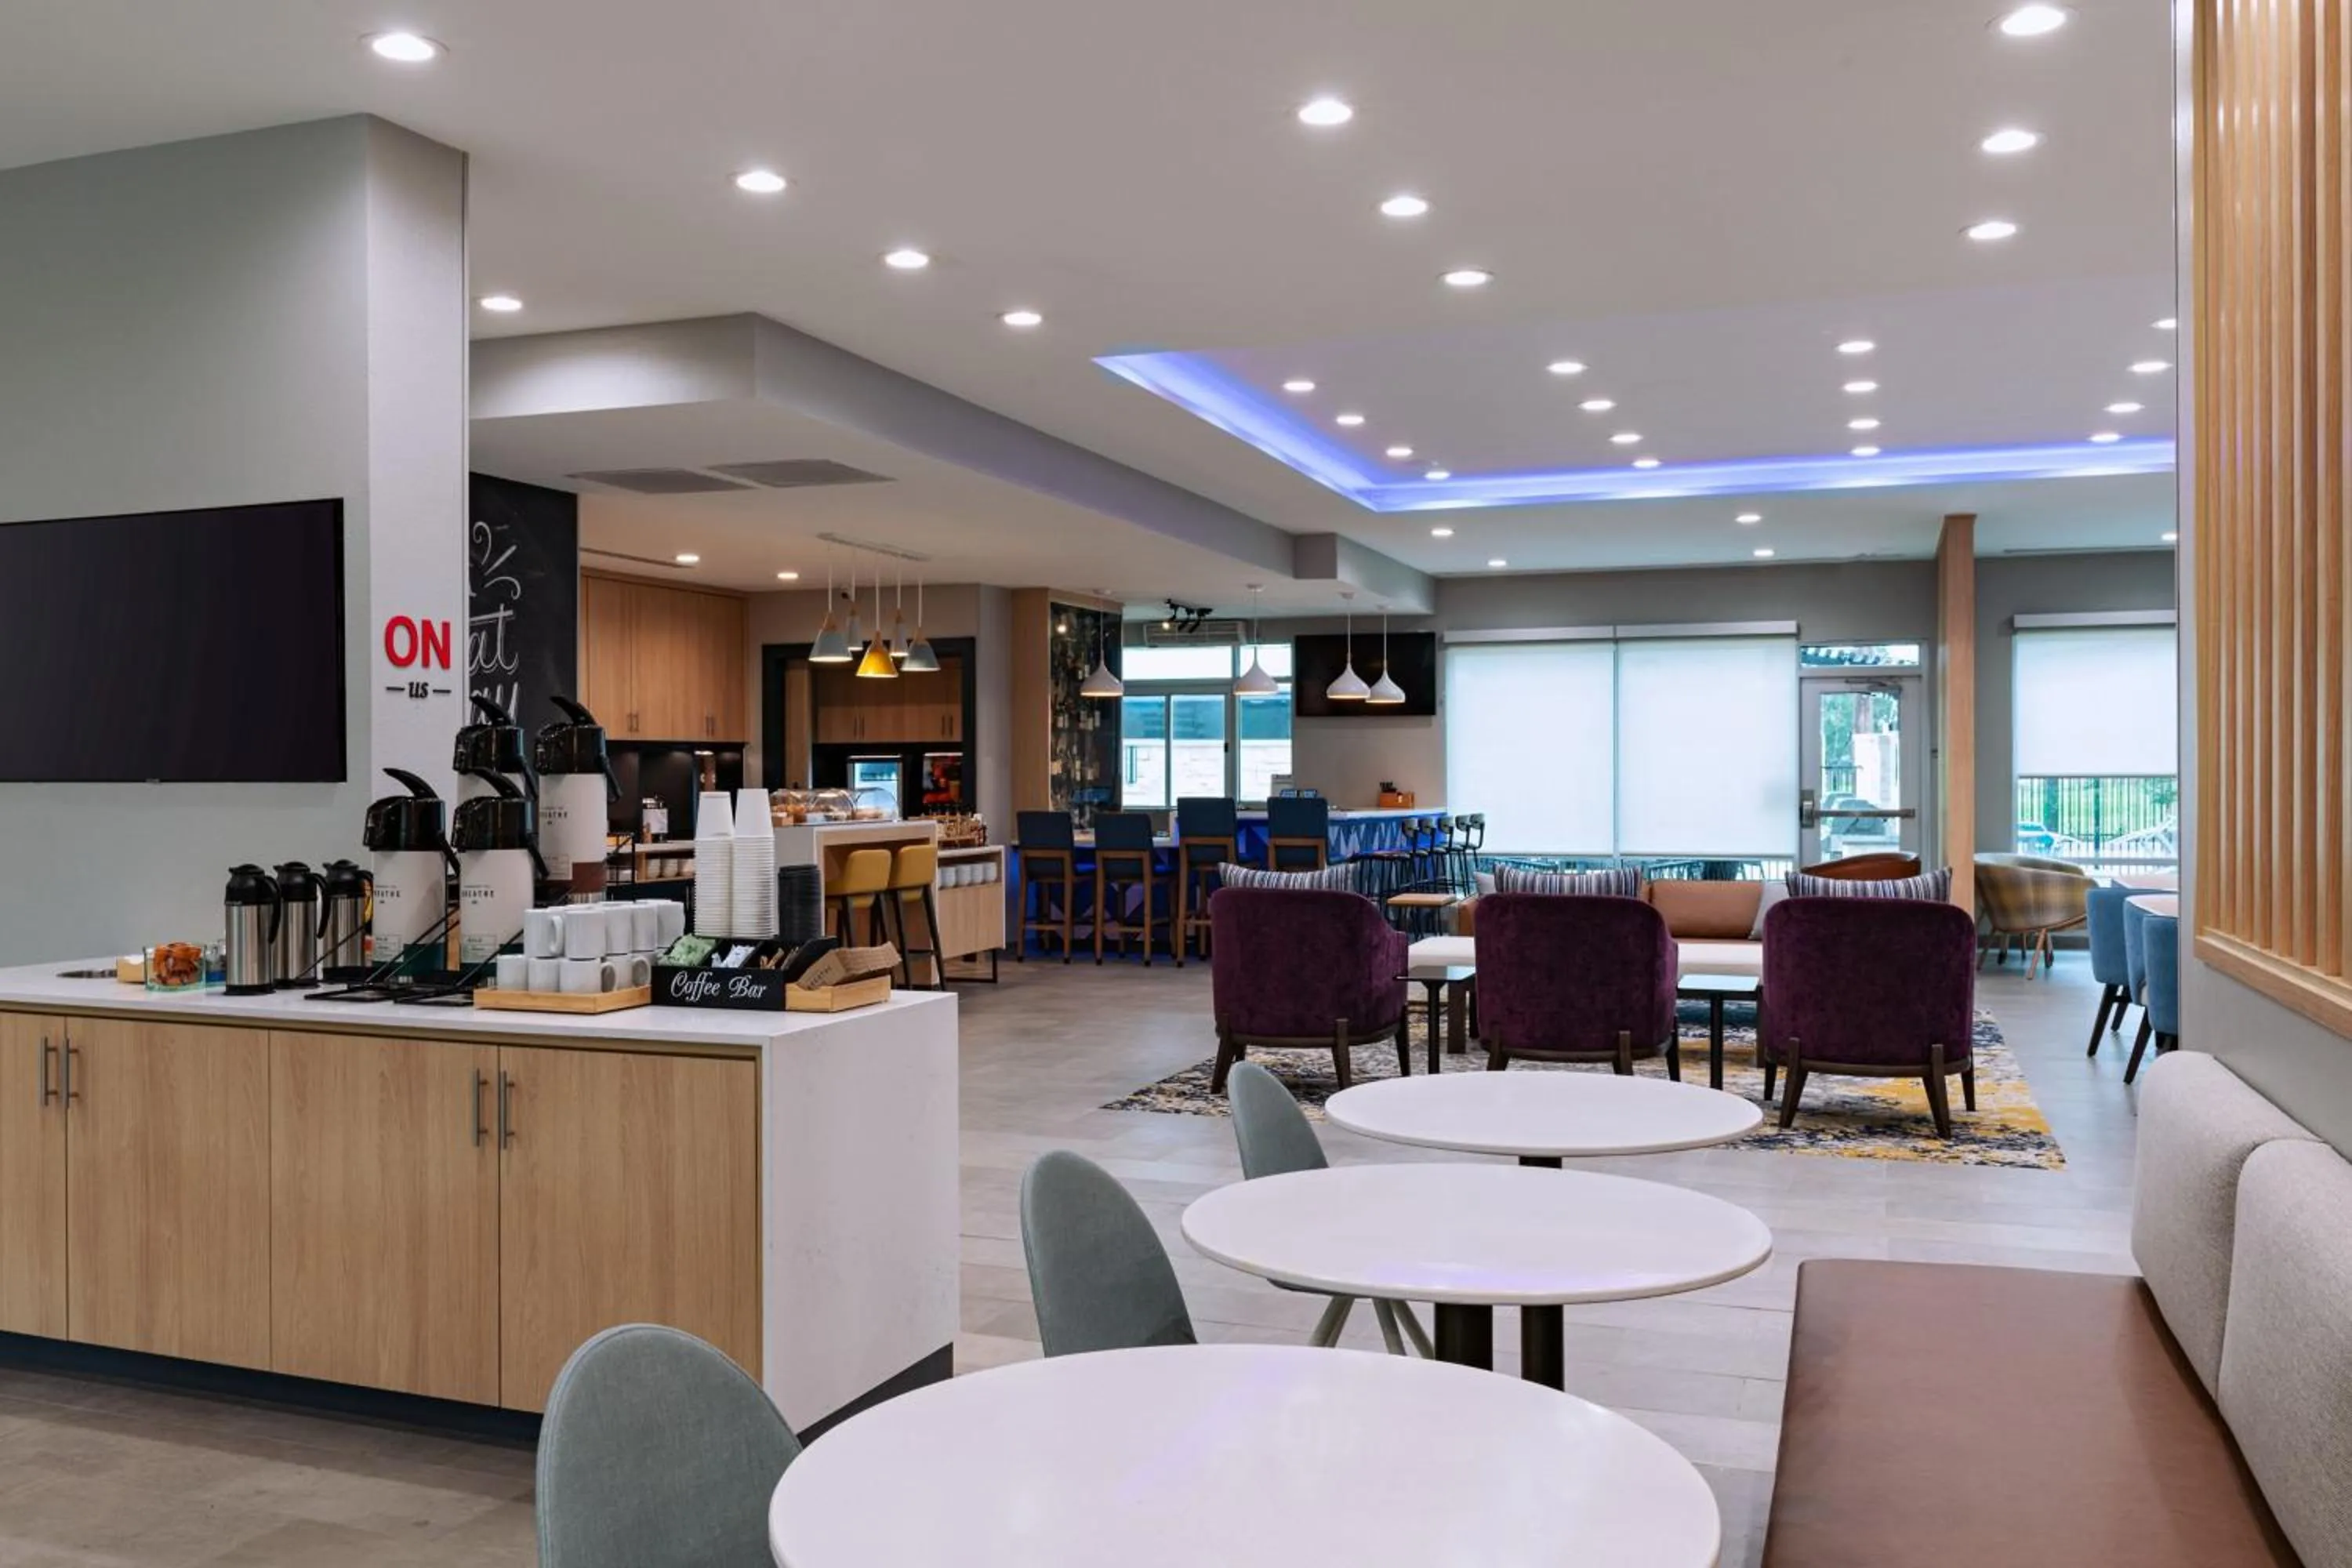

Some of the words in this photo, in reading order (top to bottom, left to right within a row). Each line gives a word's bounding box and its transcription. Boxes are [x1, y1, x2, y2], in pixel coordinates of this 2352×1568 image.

[384, 615, 451, 670] ON
[408, 681, 430, 699] us
[670, 970, 720, 1002] Coffee
[728, 975, 767, 998] Bar
